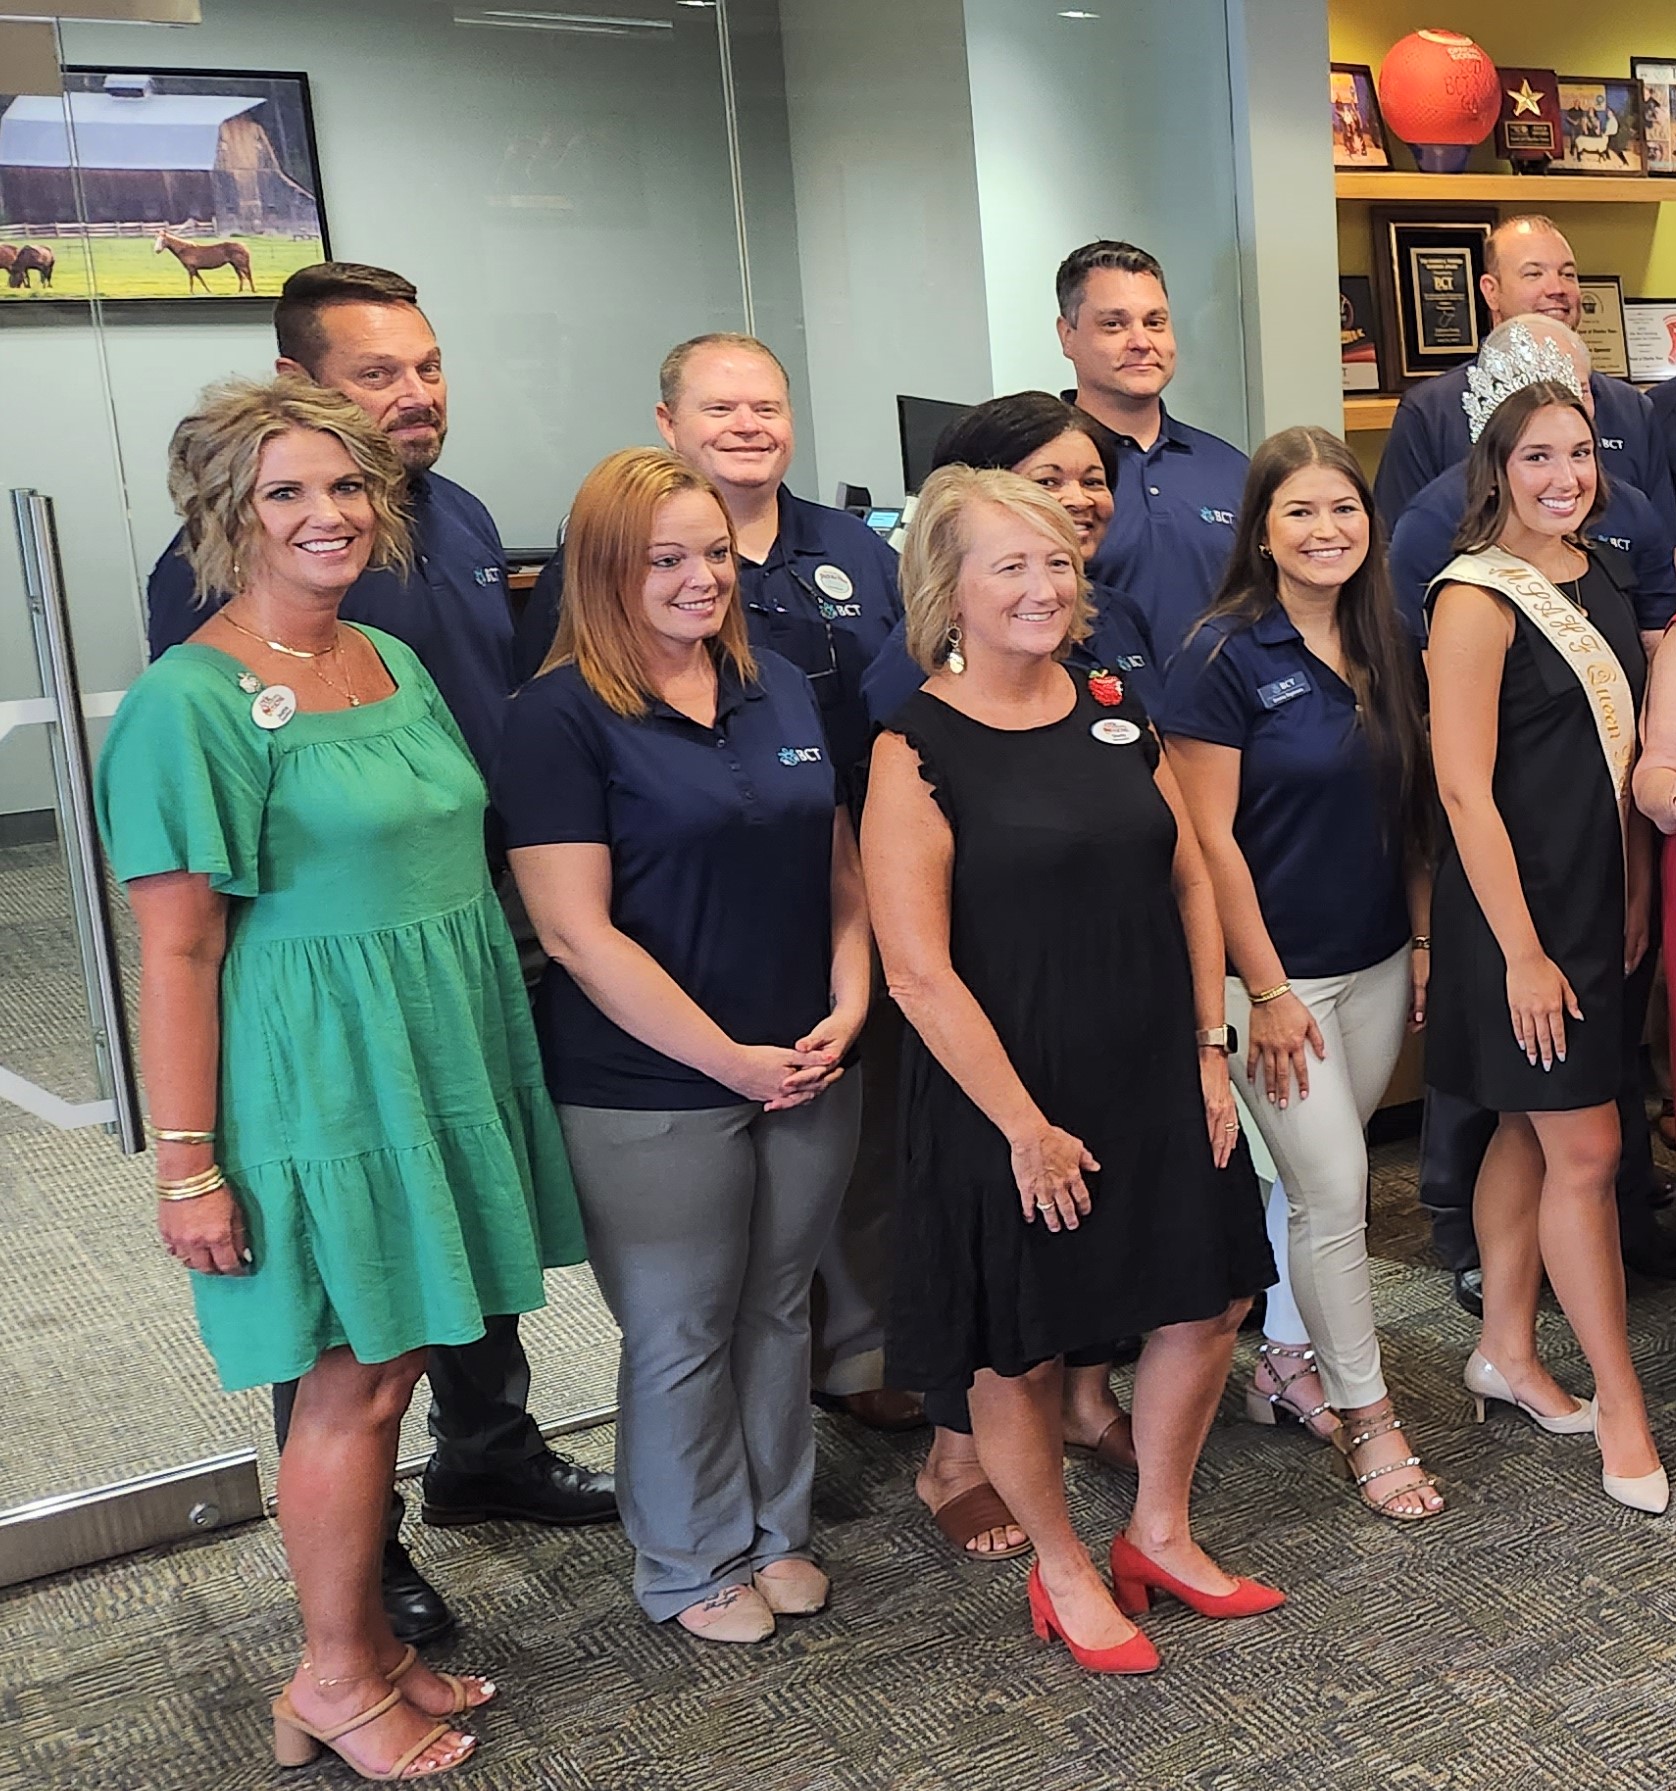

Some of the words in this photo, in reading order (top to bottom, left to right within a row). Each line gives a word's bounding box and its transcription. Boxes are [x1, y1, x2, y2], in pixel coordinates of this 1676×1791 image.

[1601, 438, 1624, 450] BCT
[1212, 509, 1235, 525] BCT
[836, 604, 861, 617] BCT
[795, 747, 822, 761] BCT
